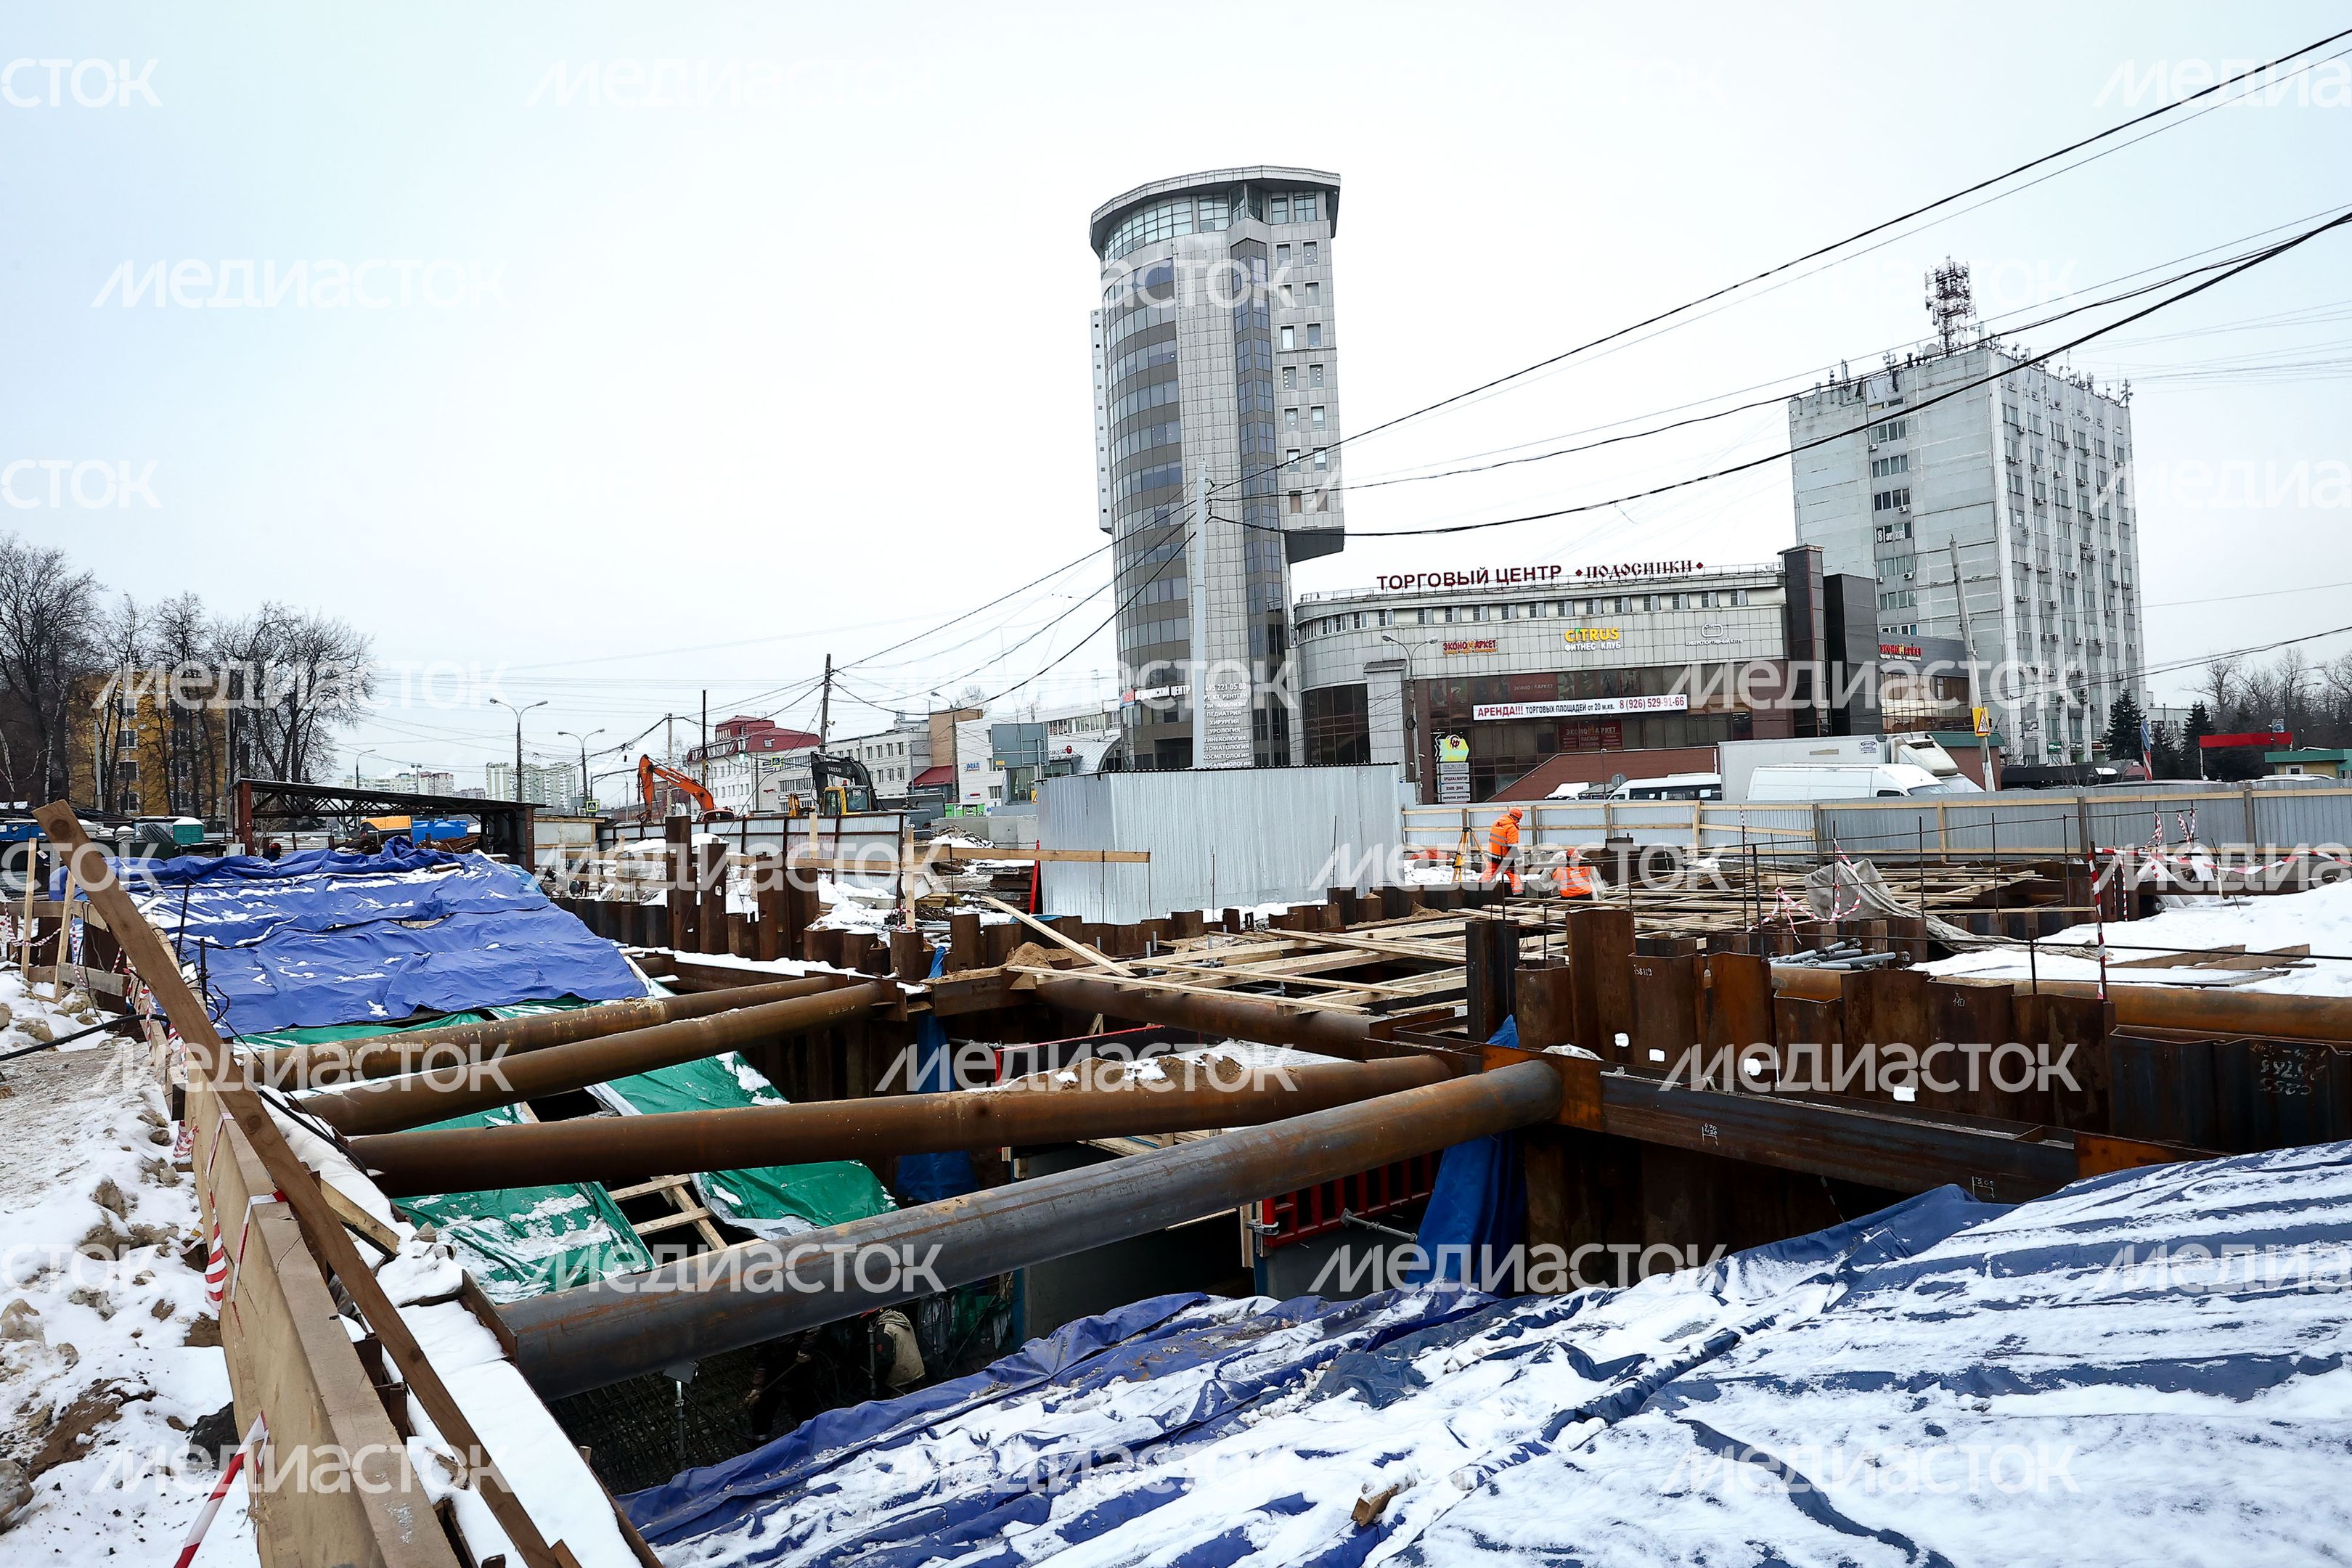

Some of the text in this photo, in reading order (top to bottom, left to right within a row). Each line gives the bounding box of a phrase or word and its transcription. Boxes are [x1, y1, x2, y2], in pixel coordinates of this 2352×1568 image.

[1377, 566, 1489, 591] ТОРГОВЫЙ
[1496, 565, 1562, 587] ЦЕНТР
[1564, 641, 1622, 652] ФИТНЕС КЛУБ
[1171, 685, 1191, 697] ЦЕНТР
[1477, 706, 1524, 717] АРЕНДА!!!
[1525, 706, 1555, 714] ТОРГОВЫХ
[1556, 702, 1587, 714] ПЛОЩАДЕЙ
[1619, 699, 1625, 709] 8
[1626, 698, 1646, 711] (926)
[1647, 696, 1685, 709] 529-91-66
